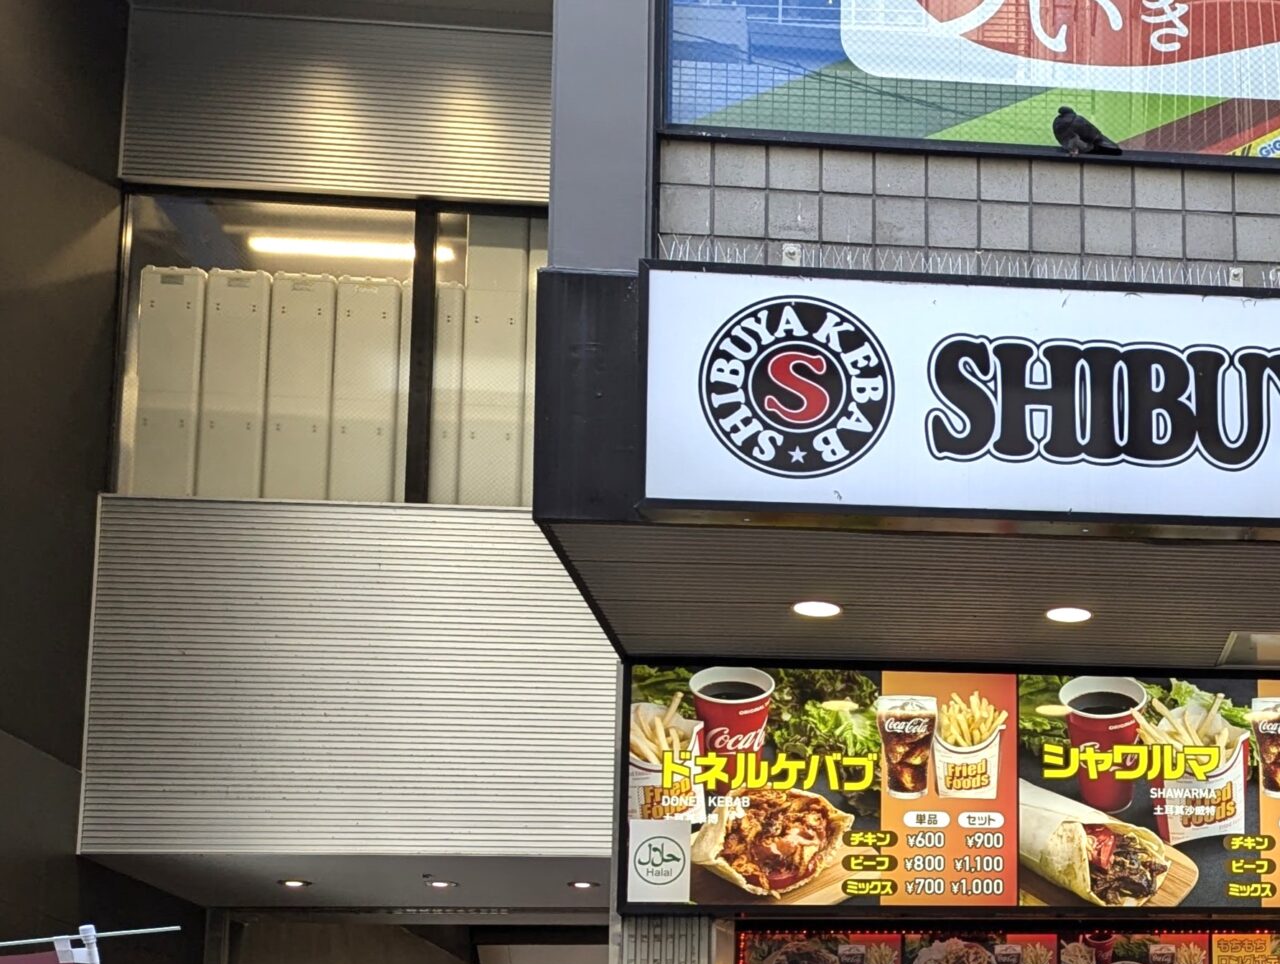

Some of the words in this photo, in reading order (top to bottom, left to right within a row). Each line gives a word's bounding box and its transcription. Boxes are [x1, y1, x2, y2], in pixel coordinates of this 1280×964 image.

[709, 303, 805, 461] SHIBUYA
[813, 308, 886, 462] KEBAB
[946, 758, 988, 778] Fried
[1042, 744, 1221, 781] シャワルマ
[661, 750, 879, 792] ドネルケバブ
[944, 772, 990, 791] Foods
[1150, 787, 1217, 799] SHAWARMA
[661, 795, 703, 808] DONE
[708, 795, 750, 808] KEBAB
[915, 813, 939, 826] 単品
[966, 814, 997, 827] セット
[850, 832, 888, 848] チキン
[907, 832, 945, 849] ¥600
[966, 832, 1003, 849] ¥900
[1230, 836, 1269, 851] チキン
[850, 857, 889, 872] ビーフ
[905, 855, 945, 872] ¥800
[954, 855, 1003, 873] ¥1,100
[1231, 860, 1269, 875] ビーフ
[646, 867, 673, 878] Halal
[846, 881, 894, 896] ミックス
[905, 879, 945, 896] ¥700
[951, 879, 1003, 897] ¥1,000
[1228, 883, 1272, 898] ミックス
[1217, 939, 1267, 953] もちもち
